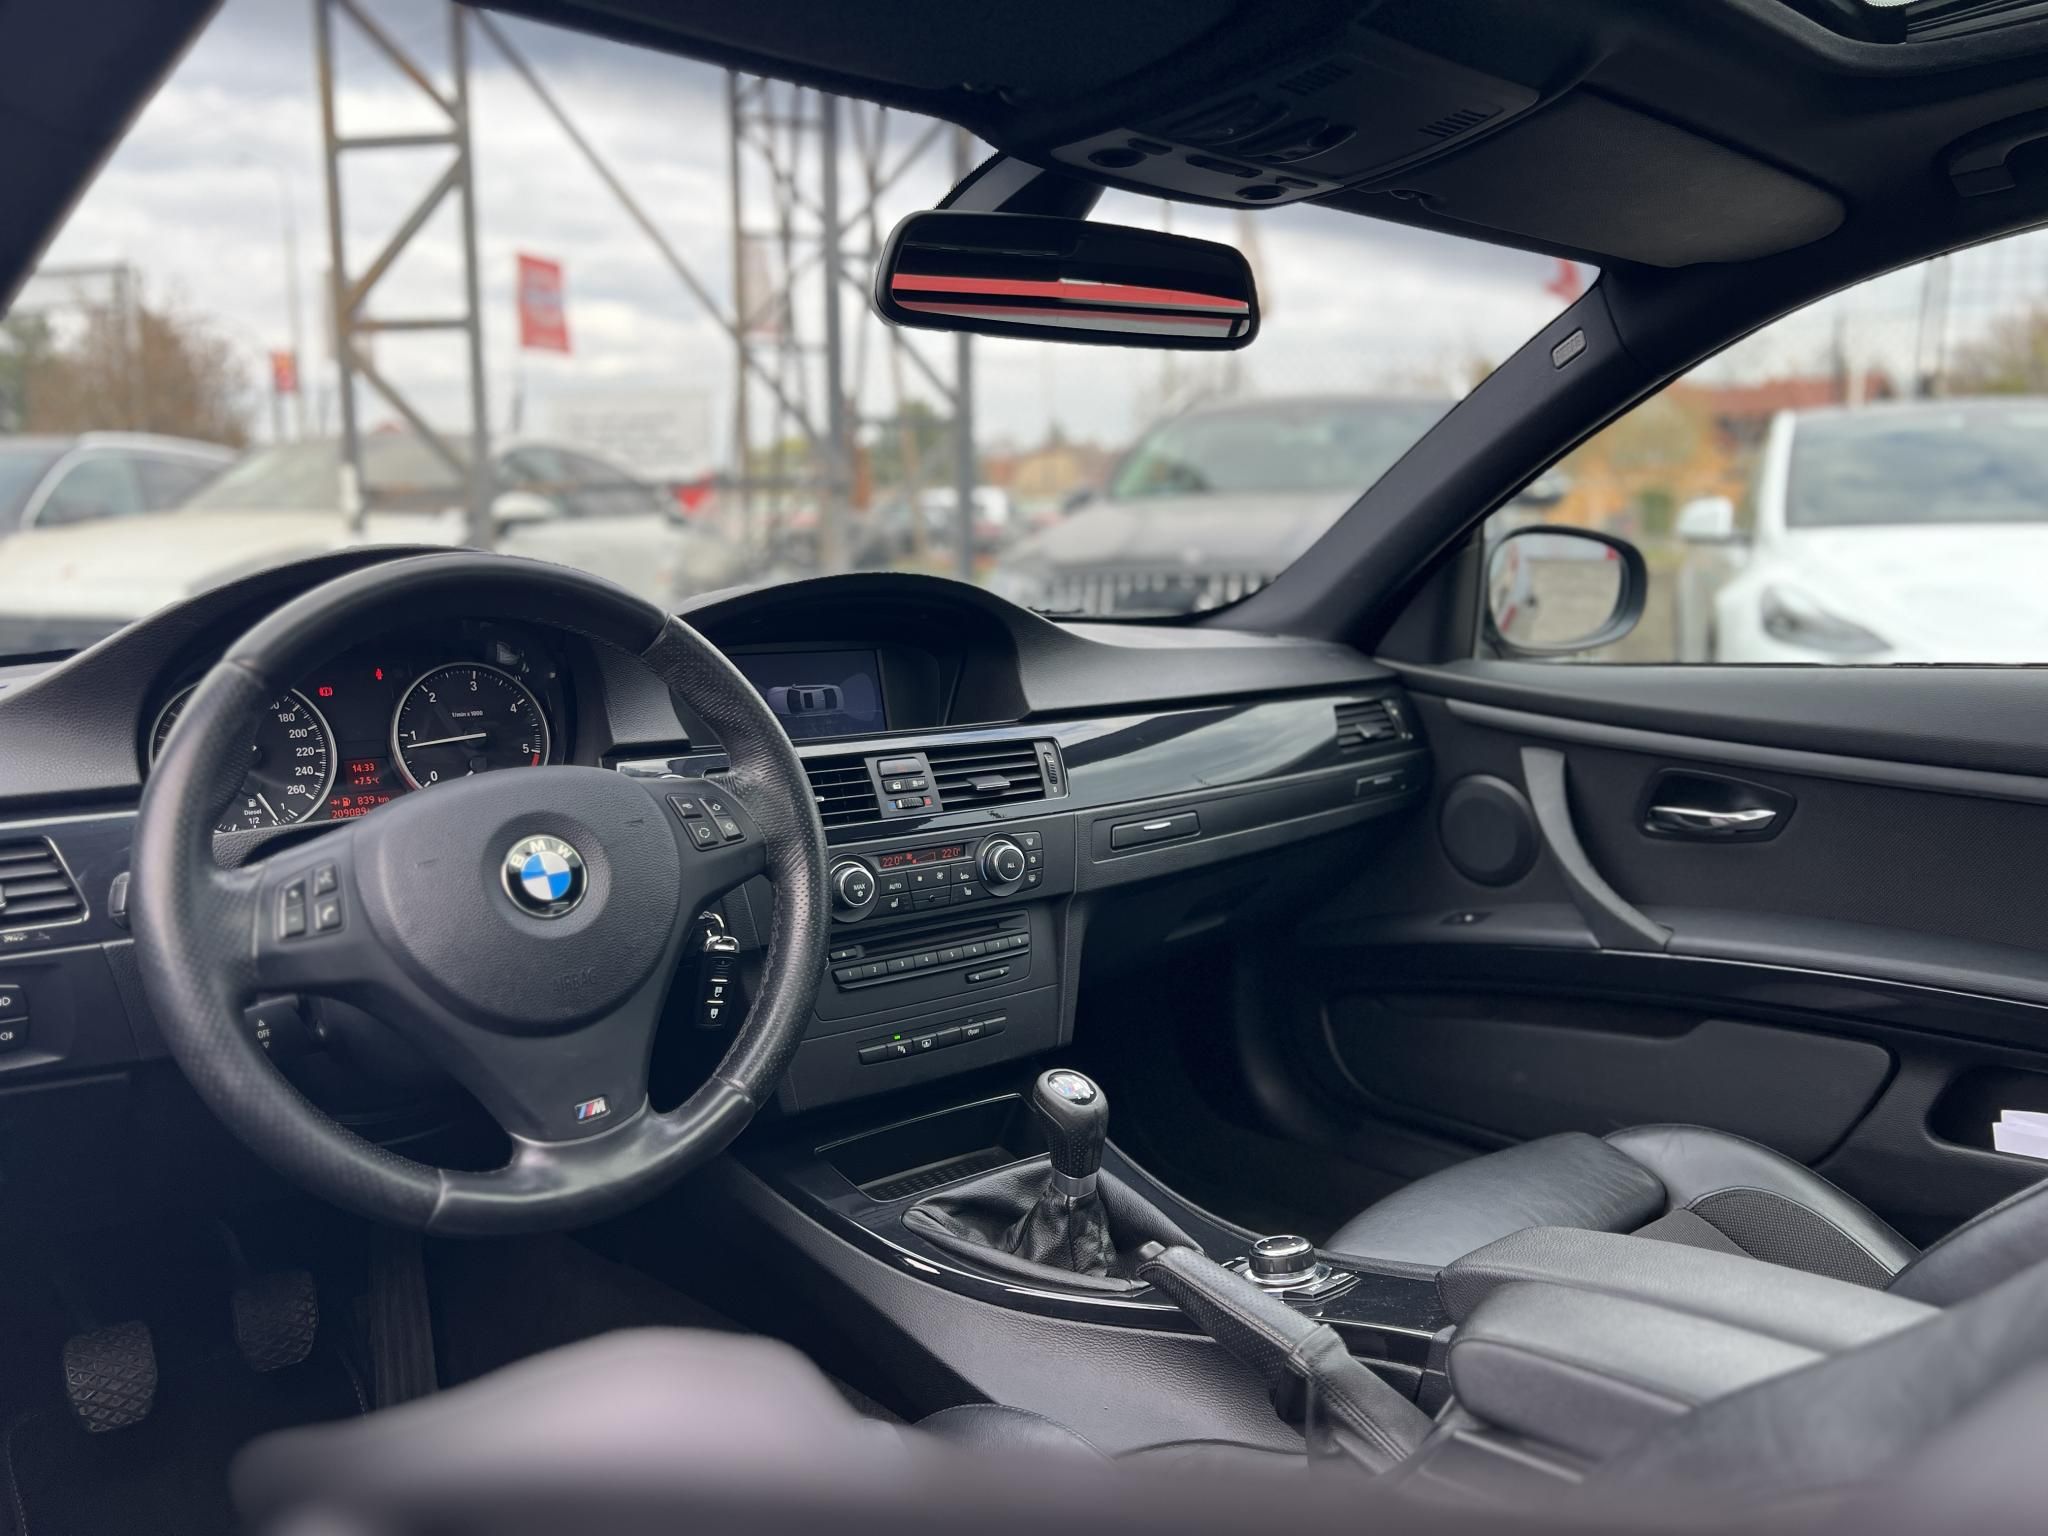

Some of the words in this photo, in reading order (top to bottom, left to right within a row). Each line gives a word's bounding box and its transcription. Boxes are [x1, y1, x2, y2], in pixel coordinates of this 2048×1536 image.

[470, 681, 478, 691] 3
[429, 693, 437, 703] 2
[510, 703, 517, 713] 4
[278, 713, 296, 723] 180
[289, 729, 308, 739] 200
[410, 730, 417, 741] 1
[296, 747, 315, 757] 220
[522, 743, 530, 754] 5
[295, 766, 314, 776] 240
[430, 771, 438, 782] 0
[287, 785, 306, 795] 260
[357, 795, 375, 805] 839
[243, 808, 263, 816] Diesel
[510, 839, 573, 868] BMW
[853, 883, 866, 891] MAX
[889, 882, 902, 890] AUTO
[257, 1029, 270, 1039] OFF
